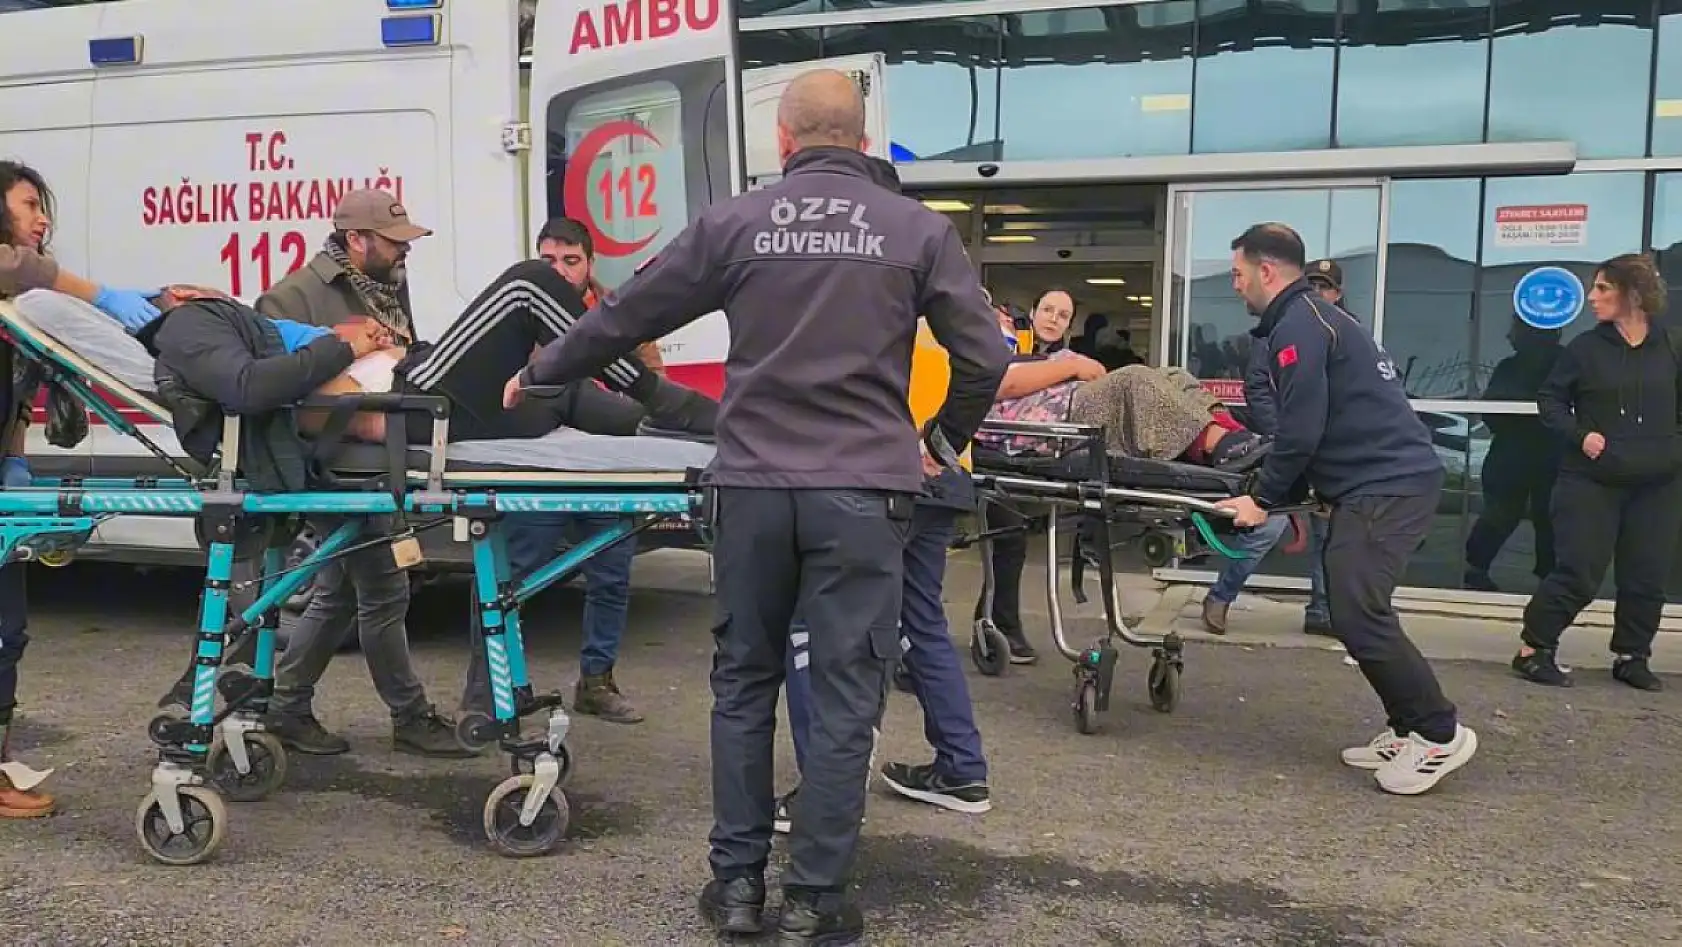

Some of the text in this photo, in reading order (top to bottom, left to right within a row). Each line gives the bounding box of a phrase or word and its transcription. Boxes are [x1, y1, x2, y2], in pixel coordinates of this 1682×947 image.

[568, 0, 719, 54] AMBU
[245, 130, 294, 171] T.C.
[143, 176, 239, 225] SAĞLIK
[599, 162, 659, 223] 112
[754, 227, 885, 257] GÜVENLİK
